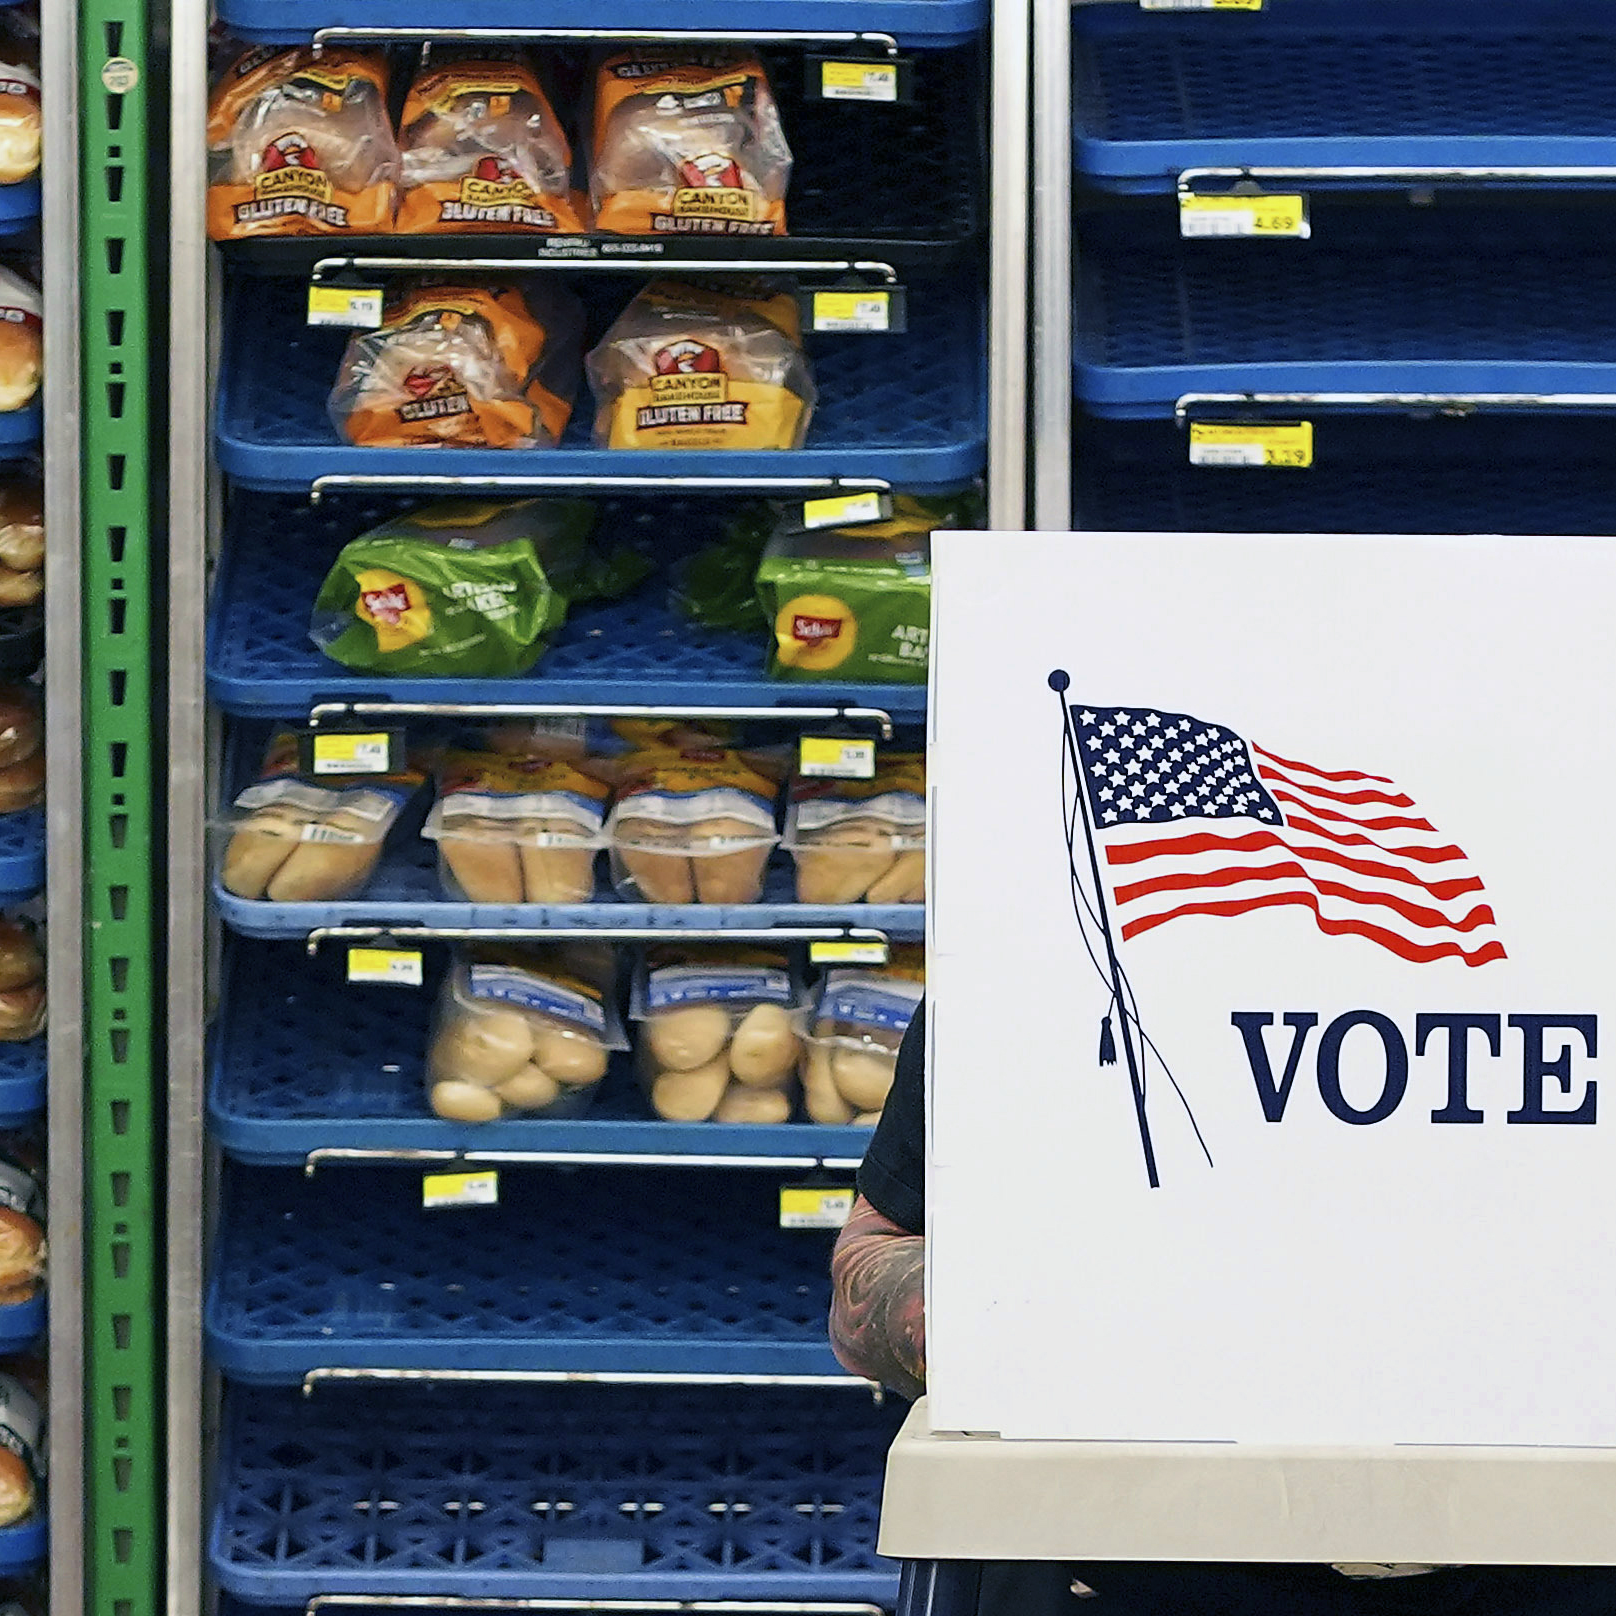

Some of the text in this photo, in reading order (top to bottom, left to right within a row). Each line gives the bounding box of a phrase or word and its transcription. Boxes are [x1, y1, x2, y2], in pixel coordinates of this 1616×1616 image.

[259, 171, 327, 190] CANYON
[679, 189, 749, 206] CANYON
[238, 200, 308, 222] GLUTEN
[652, 374, 723, 391] CANYON
[637, 403, 746, 426] GLUTEN FREE
[1231, 1010, 1598, 1126] VOTE
